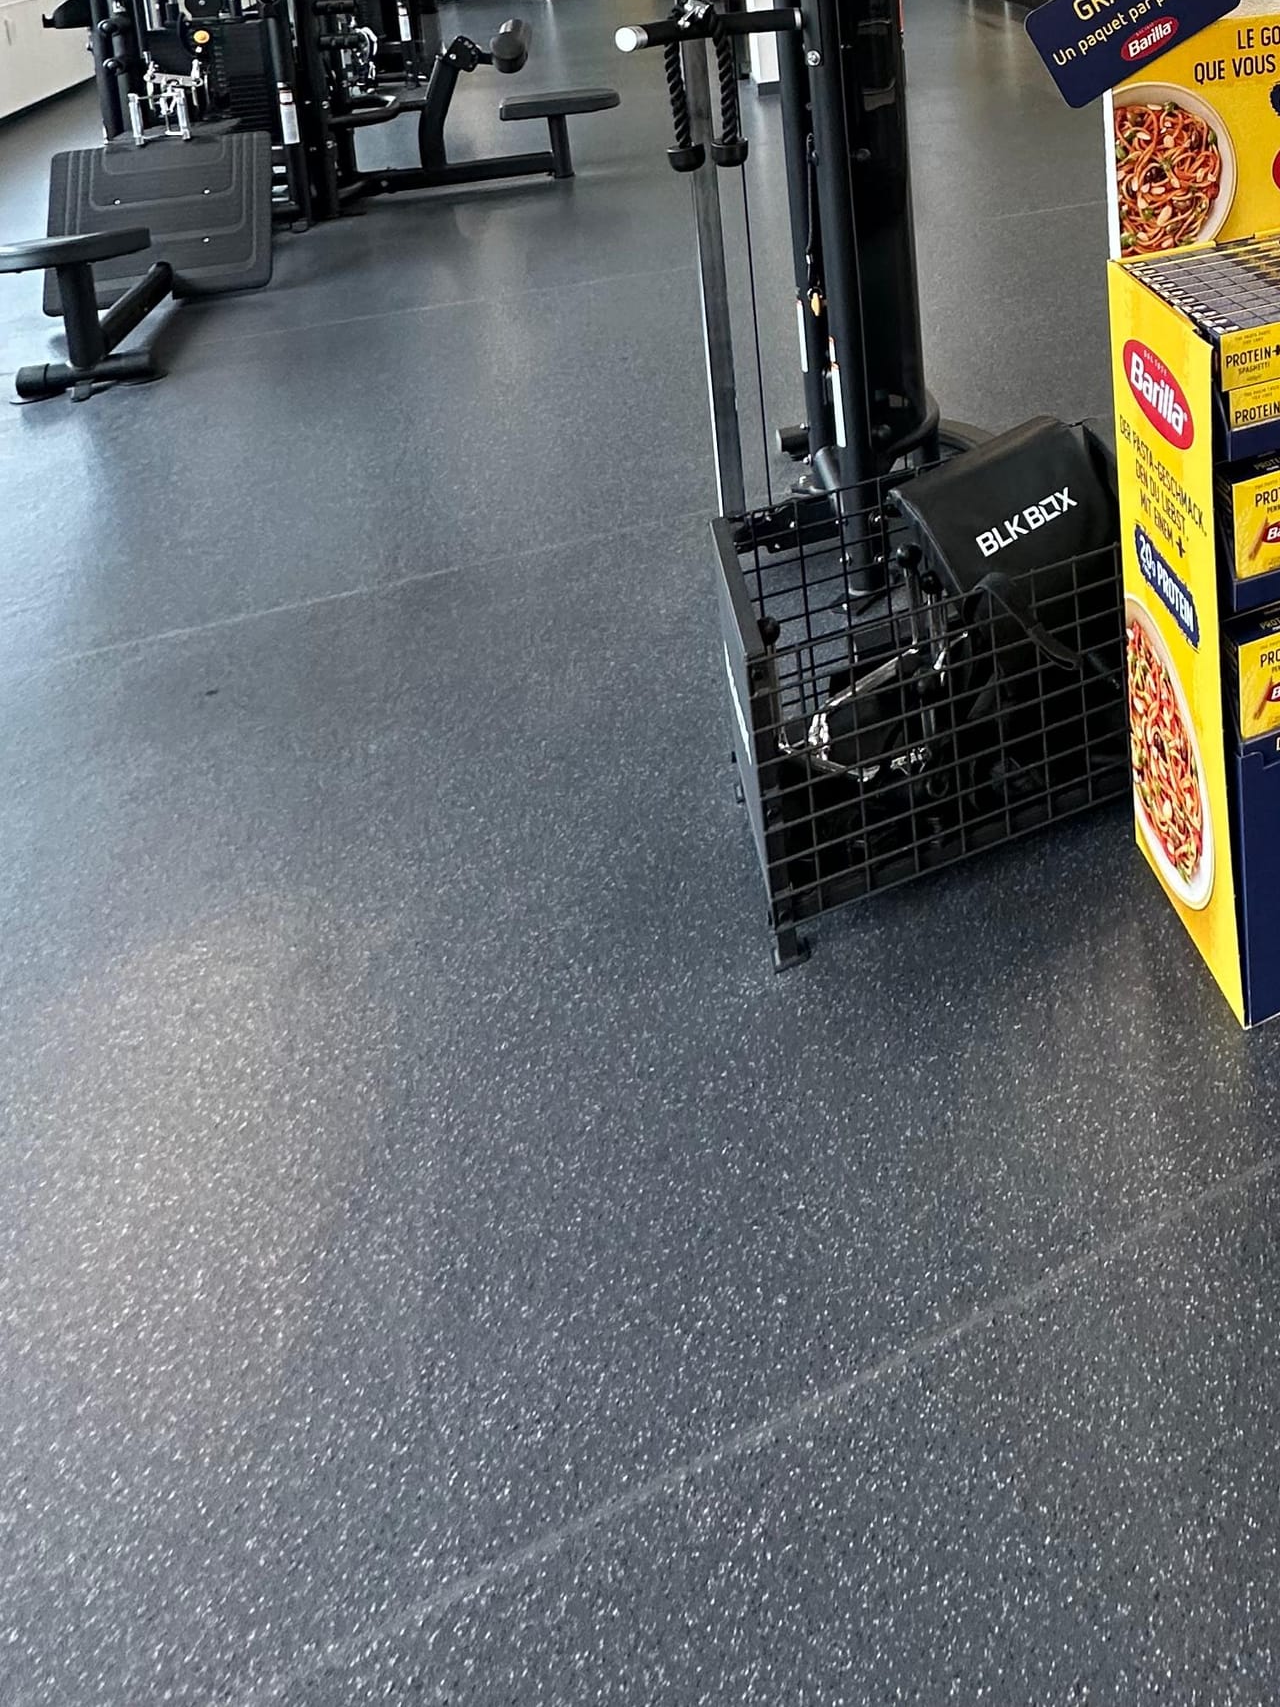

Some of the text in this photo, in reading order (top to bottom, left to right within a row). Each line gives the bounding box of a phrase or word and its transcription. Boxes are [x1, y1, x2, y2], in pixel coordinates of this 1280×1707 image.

[1053, 46, 1077, 67] Un
[1078, 13, 1128, 56] paquet
[1128, 22, 1172, 58] Barilla
[1237, 27, 1255, 50] LE
[1194, 59, 1226, 85] QUE
[1232, 53, 1276, 78] VOUS
[1130, 351, 1186, 436] Barilla
[1156, 560, 1194, 633] PROTEIN
